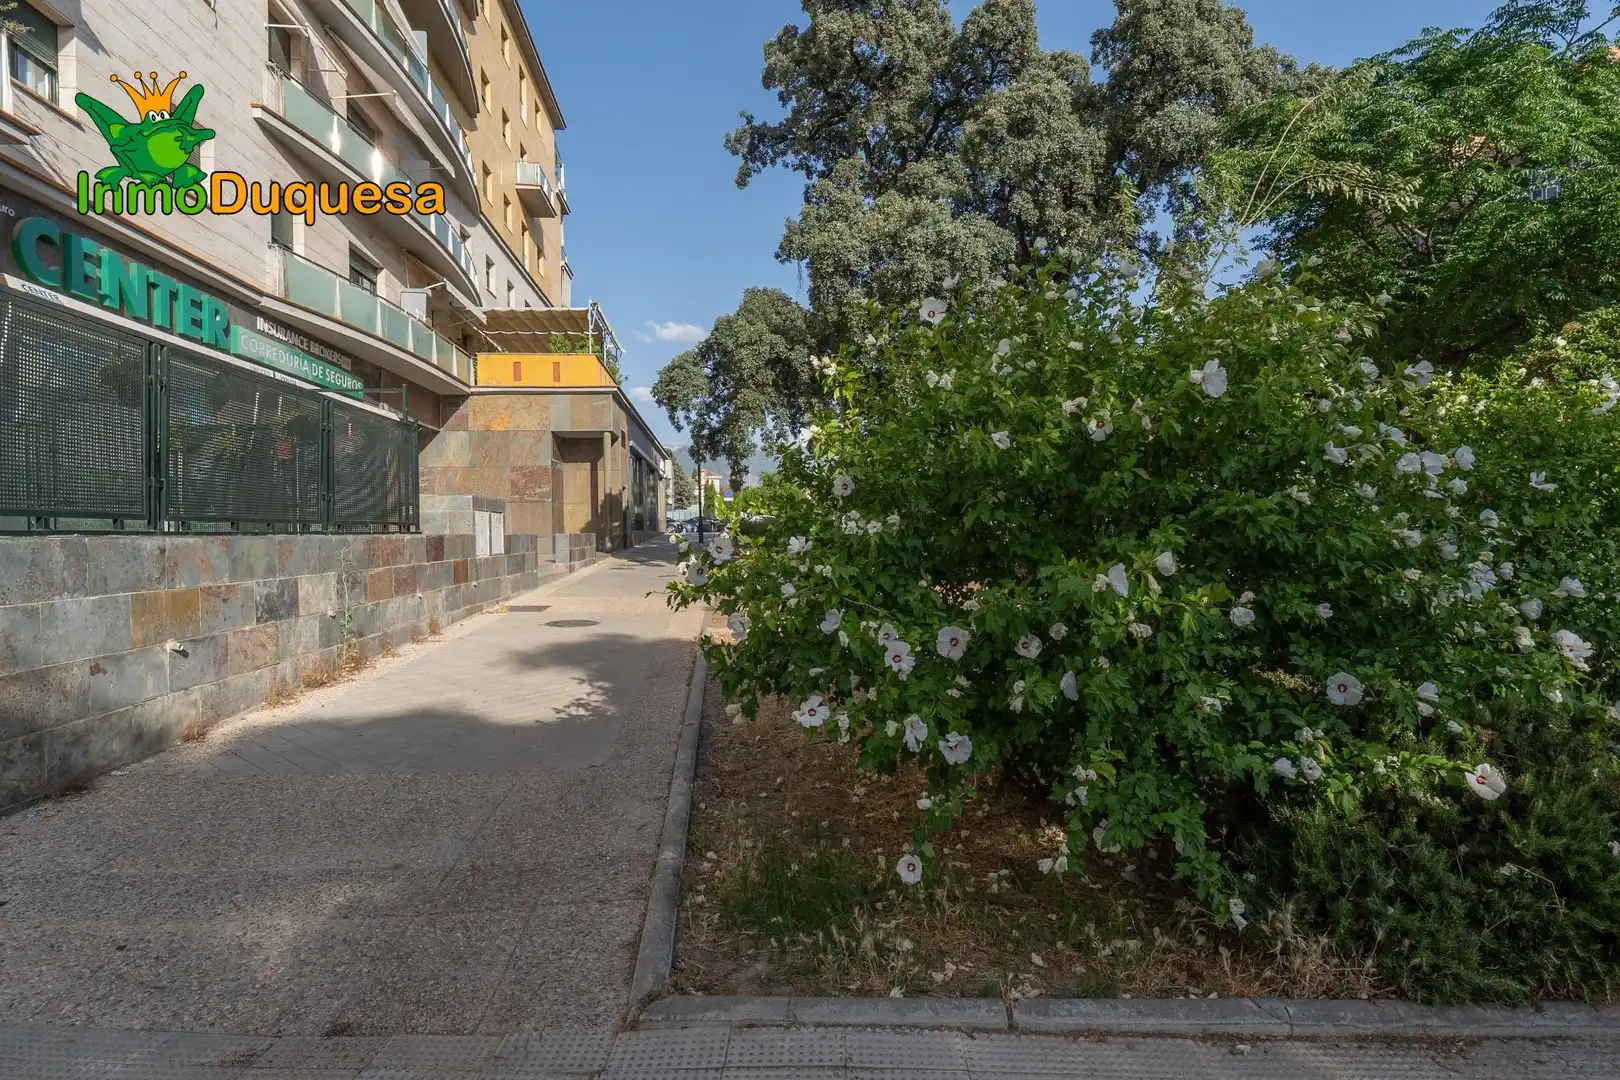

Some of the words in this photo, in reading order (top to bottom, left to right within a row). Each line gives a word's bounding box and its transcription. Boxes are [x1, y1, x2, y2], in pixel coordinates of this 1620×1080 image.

[11, 216, 229, 349] CENTER
[241, 334, 310, 374] CORREDURÍA
[311, 363, 323, 378] DE
[325, 368, 363, 394] SEGUROS
[256, 316, 309, 350] INSURANCE
[309, 341, 342, 365] BROKERS
